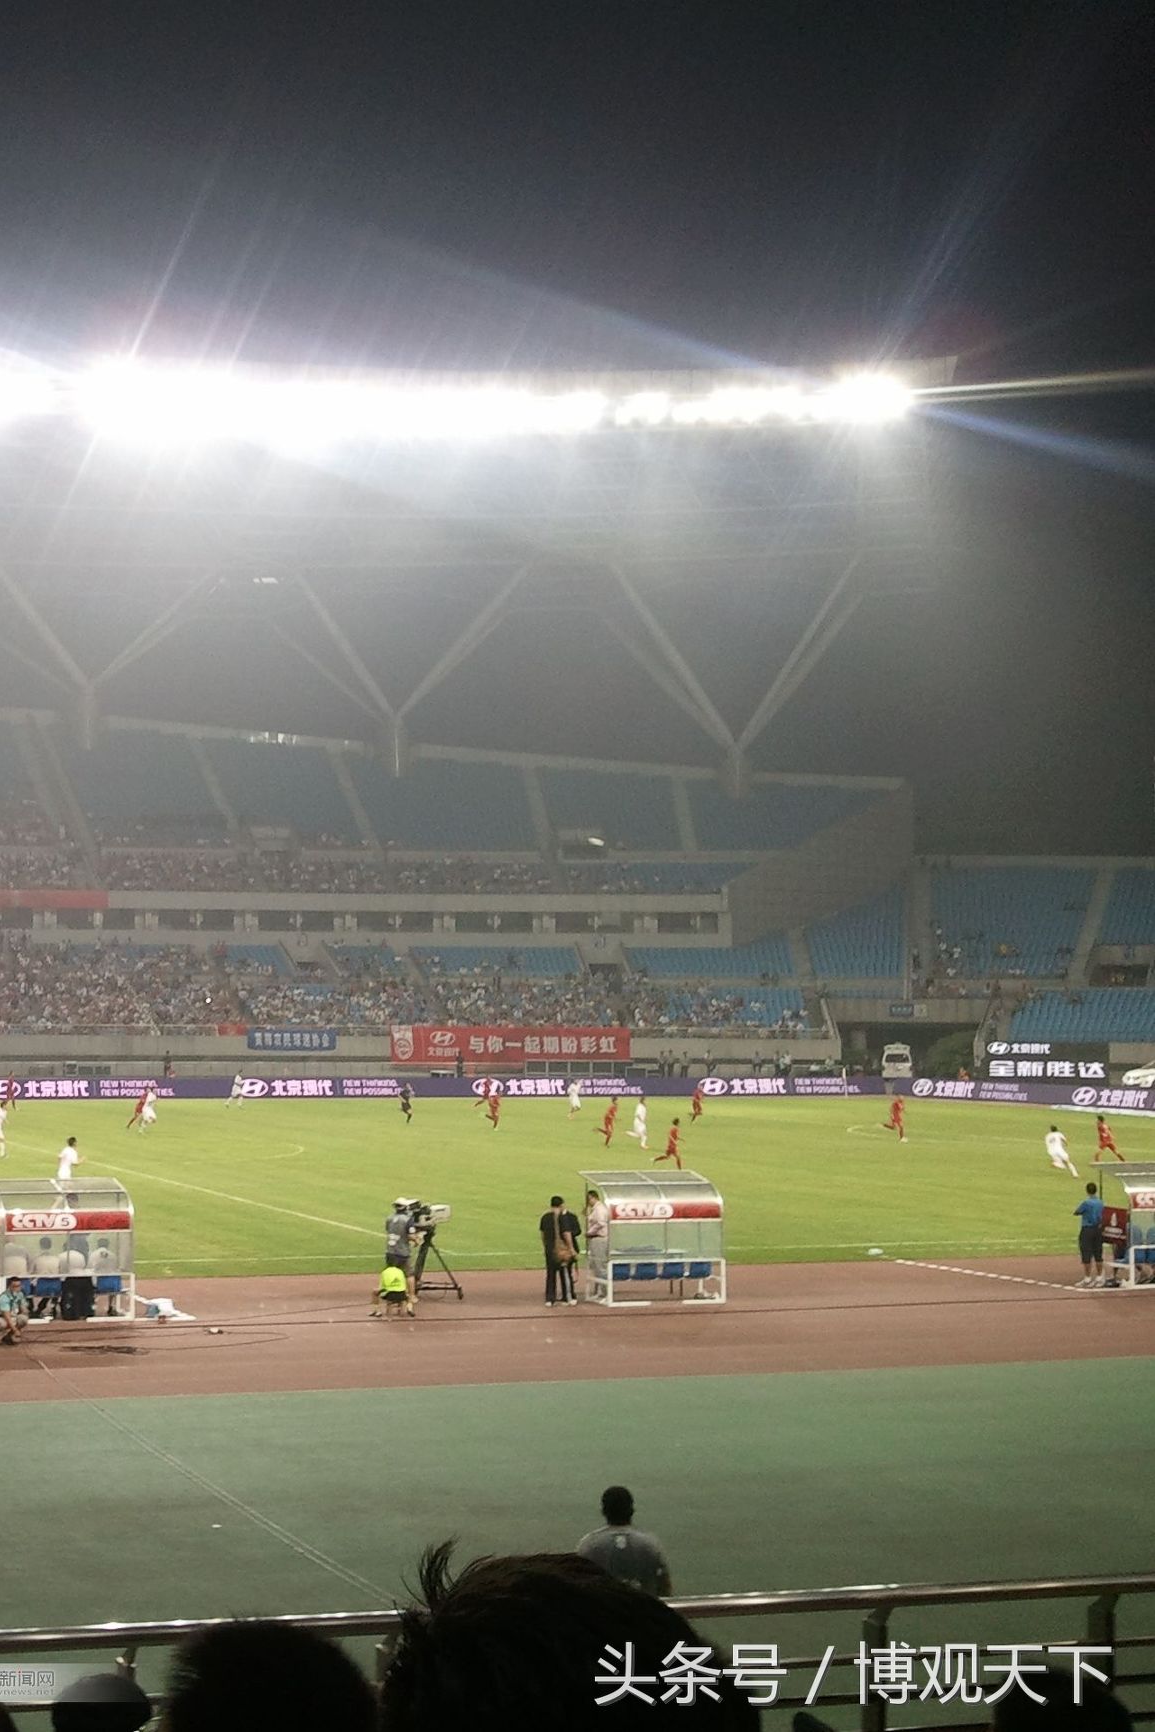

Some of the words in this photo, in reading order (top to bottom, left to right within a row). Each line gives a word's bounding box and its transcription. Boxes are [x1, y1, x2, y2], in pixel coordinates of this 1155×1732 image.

[469, 1036, 617, 1054] 与你一起期盼彩虹
[1011, 1043, 1051, 1054] 北京现代
[989, 1060, 1106, 1078] 全新胜达
[24, 1080, 89, 1097] 北京现代
[271, 1079, 333, 1096] 北京现代
[507, 1079, 565, 1095] 北京现代
[730, 1078, 786, 1094] 北京现代
[933, 1081, 975, 1098] 北京现代
[1097, 1089, 1149, 1108] 北京现代
